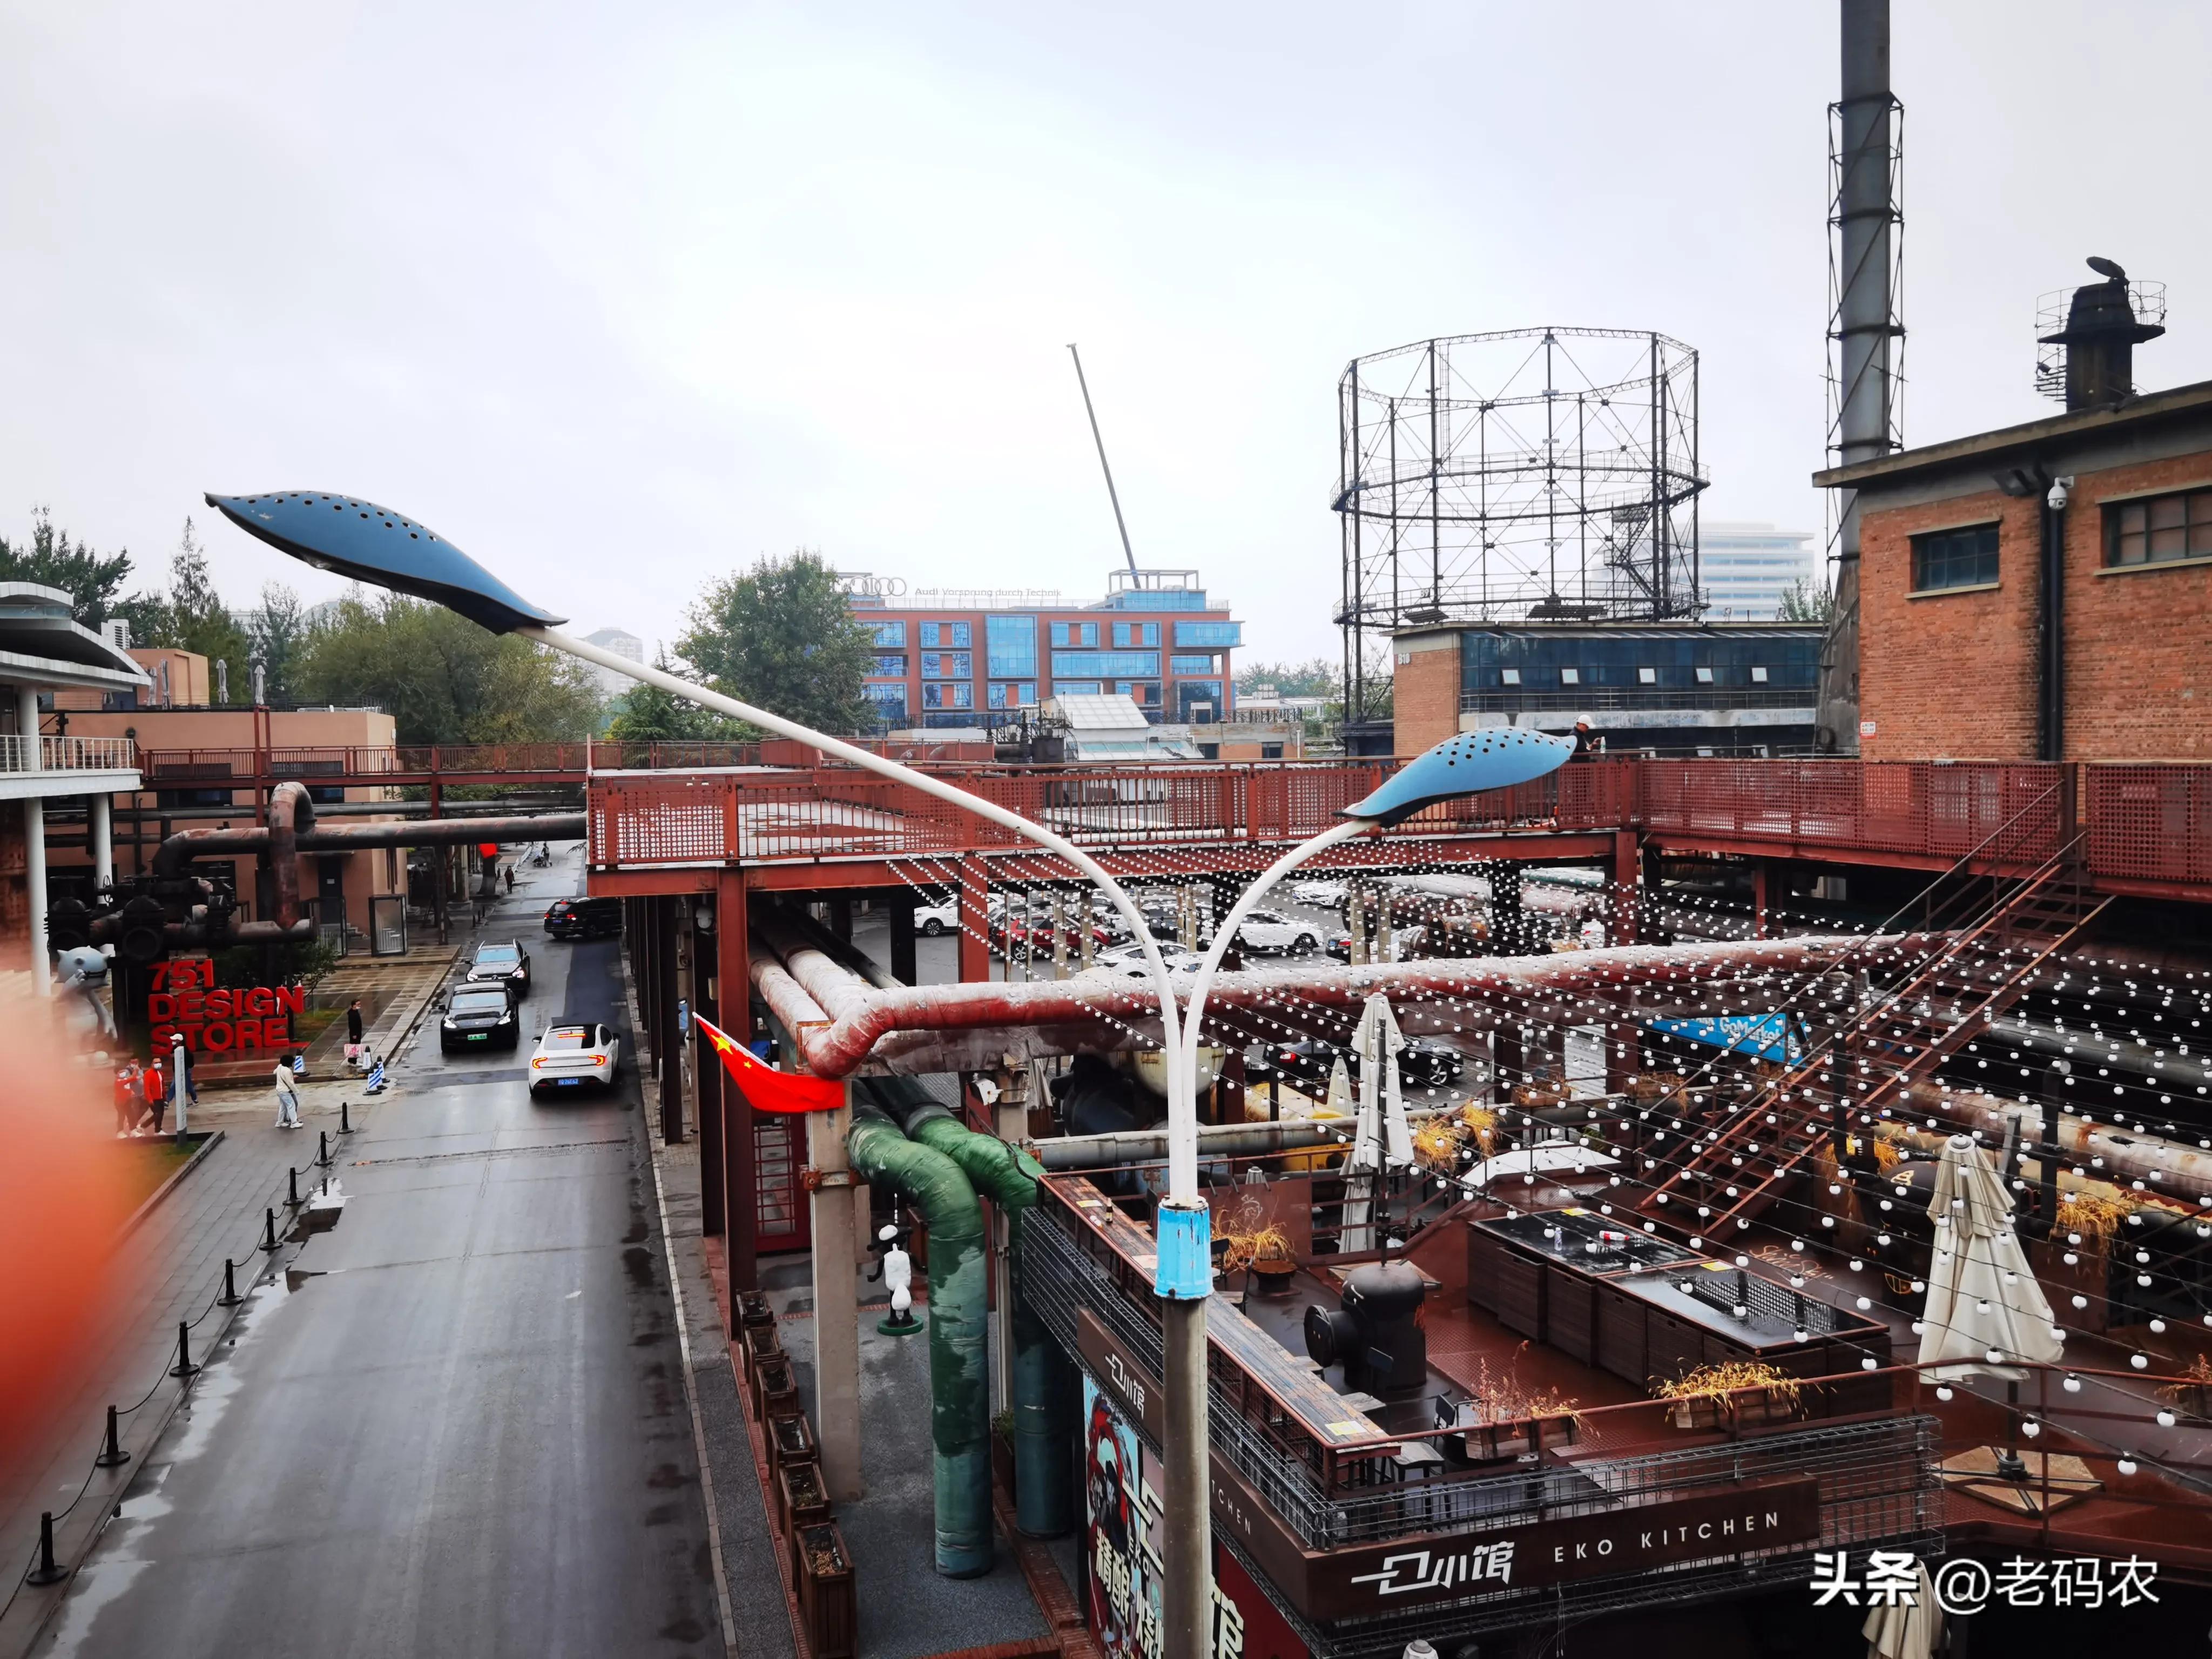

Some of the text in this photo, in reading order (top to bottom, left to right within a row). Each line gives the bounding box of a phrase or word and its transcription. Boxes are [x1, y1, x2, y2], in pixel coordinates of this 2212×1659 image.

[942, 588, 993, 597] Vorsprung
[1025, 588, 1061, 596] Technik
[1420, 588, 1429, 597] B9
[1398, 652, 1411, 665] B10
[147, 959, 214, 991] 751
[149, 986, 305, 1023] DESIGN
[151, 1018, 289, 1055] STORE
[1212, 1480, 1251, 1535] TCHEN
[1554, 1540, 1612, 1563] EKO
[1641, 1512, 1778, 1549] KITCHEN
